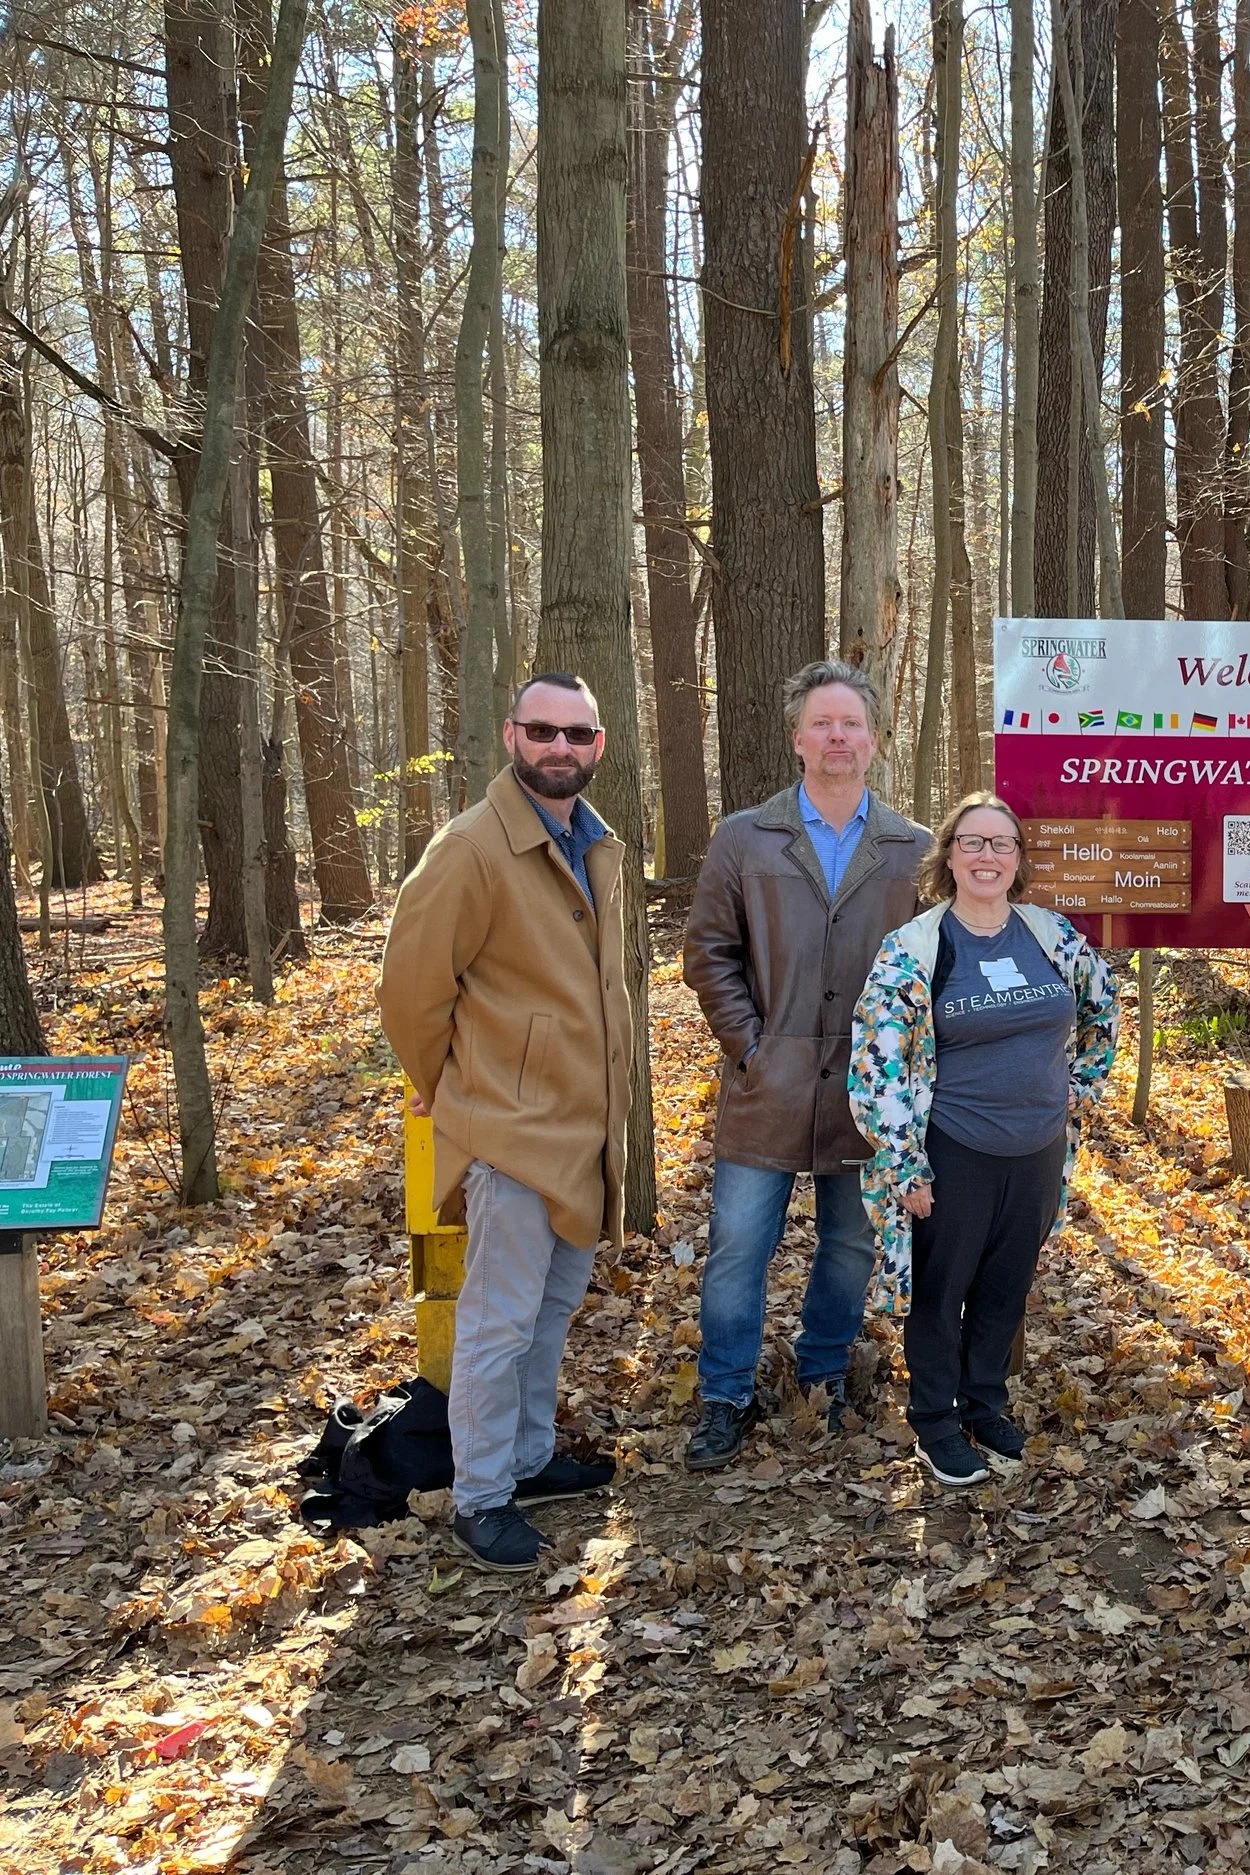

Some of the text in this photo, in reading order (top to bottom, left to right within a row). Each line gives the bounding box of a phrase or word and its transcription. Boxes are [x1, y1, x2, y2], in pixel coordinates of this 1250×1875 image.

[1022, 639, 1107, 658] SPRINGWATER
[1040, 824, 1075, 834] Shekóli
[1137, 835, 1149, 843] Olá
[1063, 843, 1113, 861] Hello
[1063, 872, 1096, 883] Bonjour
[1115, 871, 1161, 888] Moin
[1055, 894, 1087, 907] Hola
[1100, 895, 1123, 904] Hallo
[944, 983, 1071, 1014] STEAMCENTRE
[6, 1071, 74, 1081] SPRINGWATER
[75, 1070, 113, 1079] FOREST
